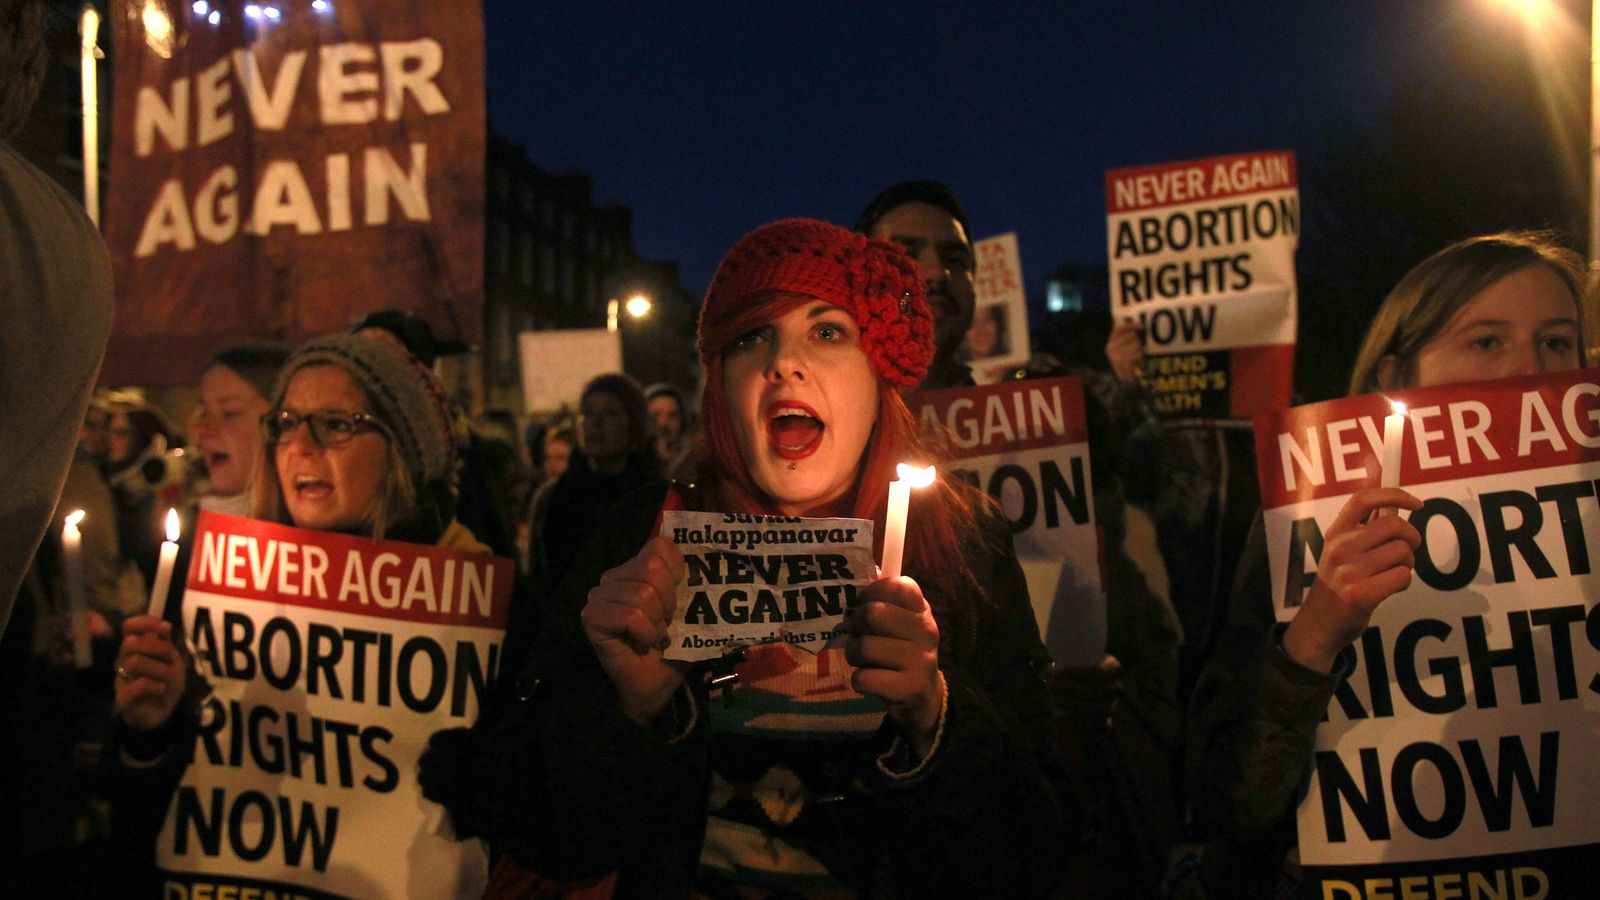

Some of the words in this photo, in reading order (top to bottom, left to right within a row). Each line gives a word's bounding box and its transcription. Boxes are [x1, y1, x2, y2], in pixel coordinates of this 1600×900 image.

[134, 38, 450, 157] NEVER
[134, 142, 431, 258] AGAIN
[1114, 168, 1206, 209] NEVER
[1210, 155, 1289, 195] AGAIN
[1115, 198, 1299, 259] ABORTION
[1119, 254, 1253, 306] RIGHTS
[920, 386, 1065, 450] AGAIN
[1278, 400, 1500, 491] NEVER
[198, 531, 330, 599] NEVER
[338, 550, 495, 617] AGAIN
[673, 525, 858, 550] Halappanavar
[684, 552, 855, 586] NEVER
[191, 607, 499, 718] ABORTION
[190, 697, 400, 793] RIGHTS
[1315, 731, 1559, 843] NOW
[173, 787, 339, 873] NOW
